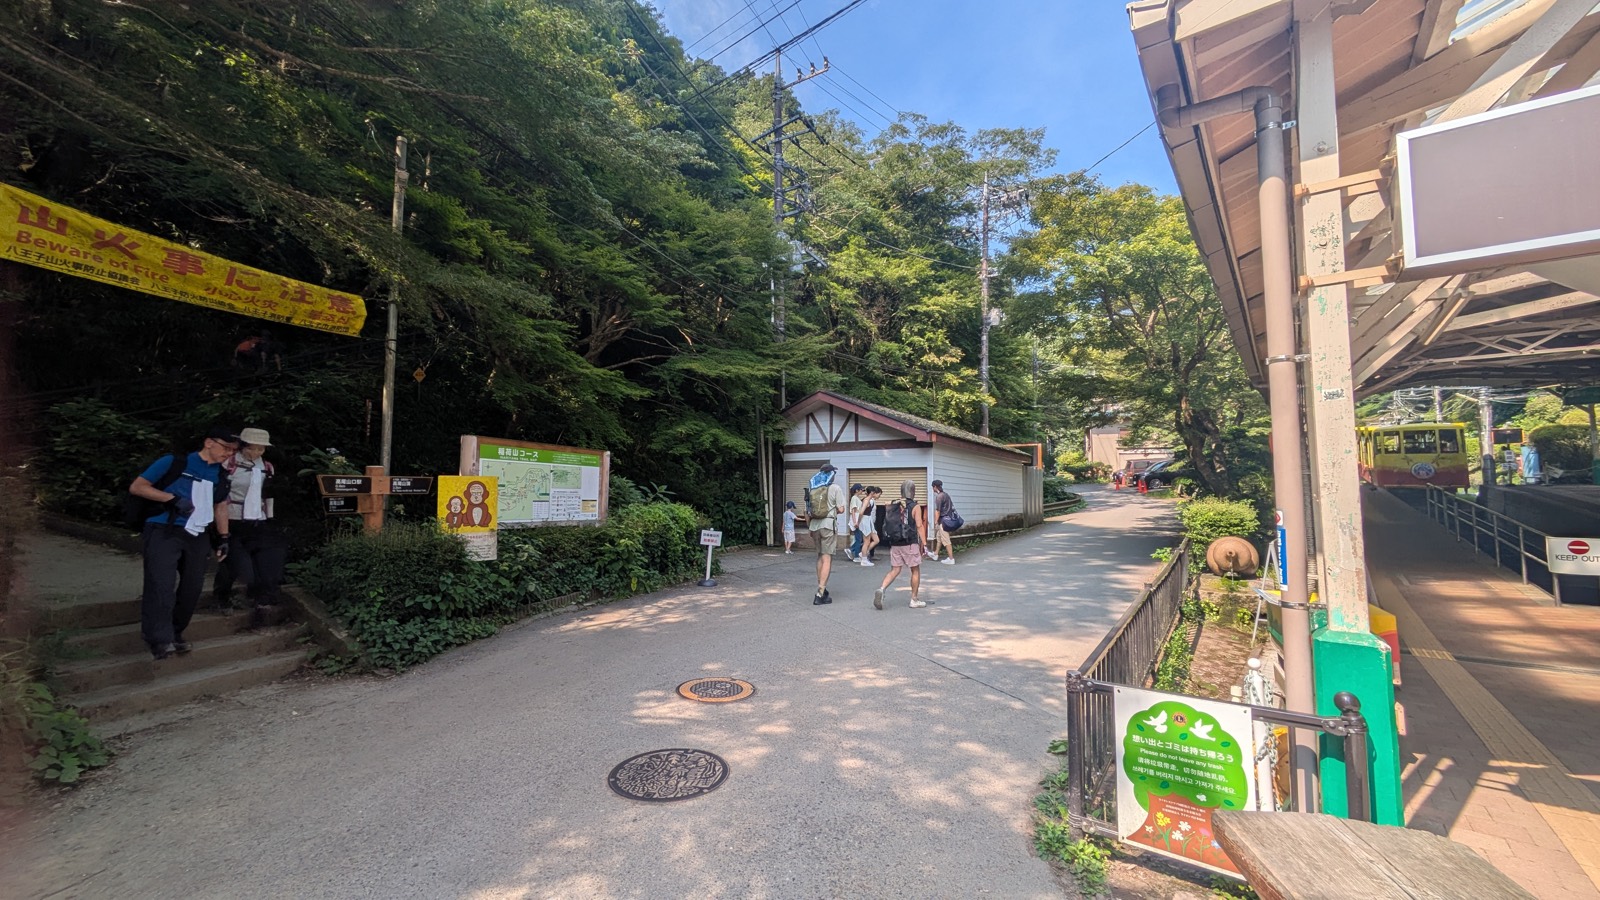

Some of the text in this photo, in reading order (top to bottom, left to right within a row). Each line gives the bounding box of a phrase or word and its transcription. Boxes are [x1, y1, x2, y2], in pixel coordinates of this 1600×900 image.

[16, 230, 170, 283] Beware of Fire
[17, 203, 357, 316] 山火事に注意
[498, 447, 539, 458] 稲荷山コース
[1555, 554, 1578, 562] KEEP
[1132, 735, 1234, 763] 想い出とゴミは持ち帰ろう
[1140, 747, 1159, 757] Please
[1159, 751, 1168, 759] do
[1168, 753, 1178, 761] not
[1178, 755, 1195, 764] leave
[1195, 759, 1207, 768] any
